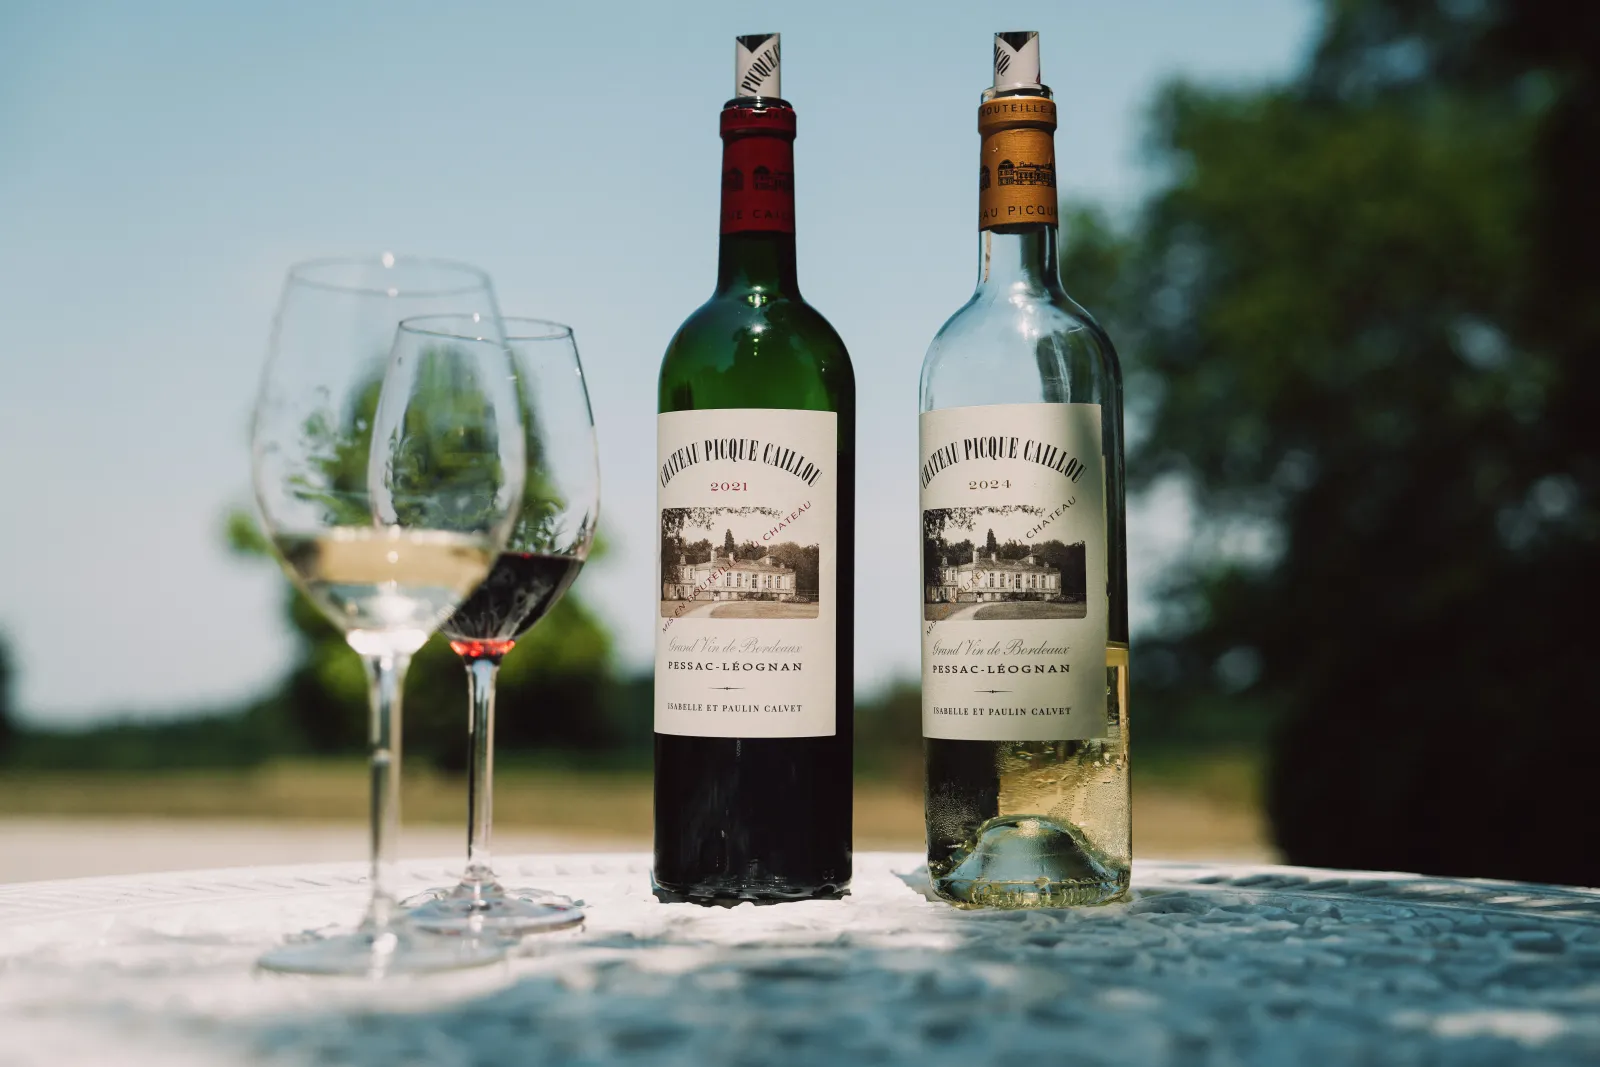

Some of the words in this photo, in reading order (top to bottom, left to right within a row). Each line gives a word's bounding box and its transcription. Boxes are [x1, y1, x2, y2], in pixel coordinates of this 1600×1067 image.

[660, 442, 700, 488] CHATEAU
[705, 438, 759, 462] PICQUE
[763, 442, 823, 488] CAILLOU
[921, 441, 960, 489] CHATEAU
[964, 436, 1019, 461] PICQUE
[1023, 439, 1087, 484] CAILLOU
[711, 482, 748, 491] 2021
[969, 479, 1012, 490] 2024
[763, 500, 812, 541] CHATEAU
[1026, 496, 1076, 539] CHATEAU
[669, 636, 699, 652] Grand
[700, 637, 720, 653] Vin
[722, 639, 736, 652] de
[739, 637, 803, 653] Bordeaux
[932, 639, 963, 656] Grand
[965, 639, 984, 656] Vin
[987, 641, 1001, 655] de
[1003, 639, 1070, 656] Bordeaux
[668, 661, 803, 672] PESSAC-LÉOGNAN
[932, 664, 1070, 674] PESSAC-LÉOGNAN
[667, 702, 703, 712] ISABELLE
[706, 704, 718, 712] ET
[722, 704, 760, 712] PAULIN
[764, 704, 803, 713] CALVET
[933, 706, 969, 715] ISABELLE
[988, 708, 1026, 716] PAULIN
[1031, 707, 1072, 715] CALVET
